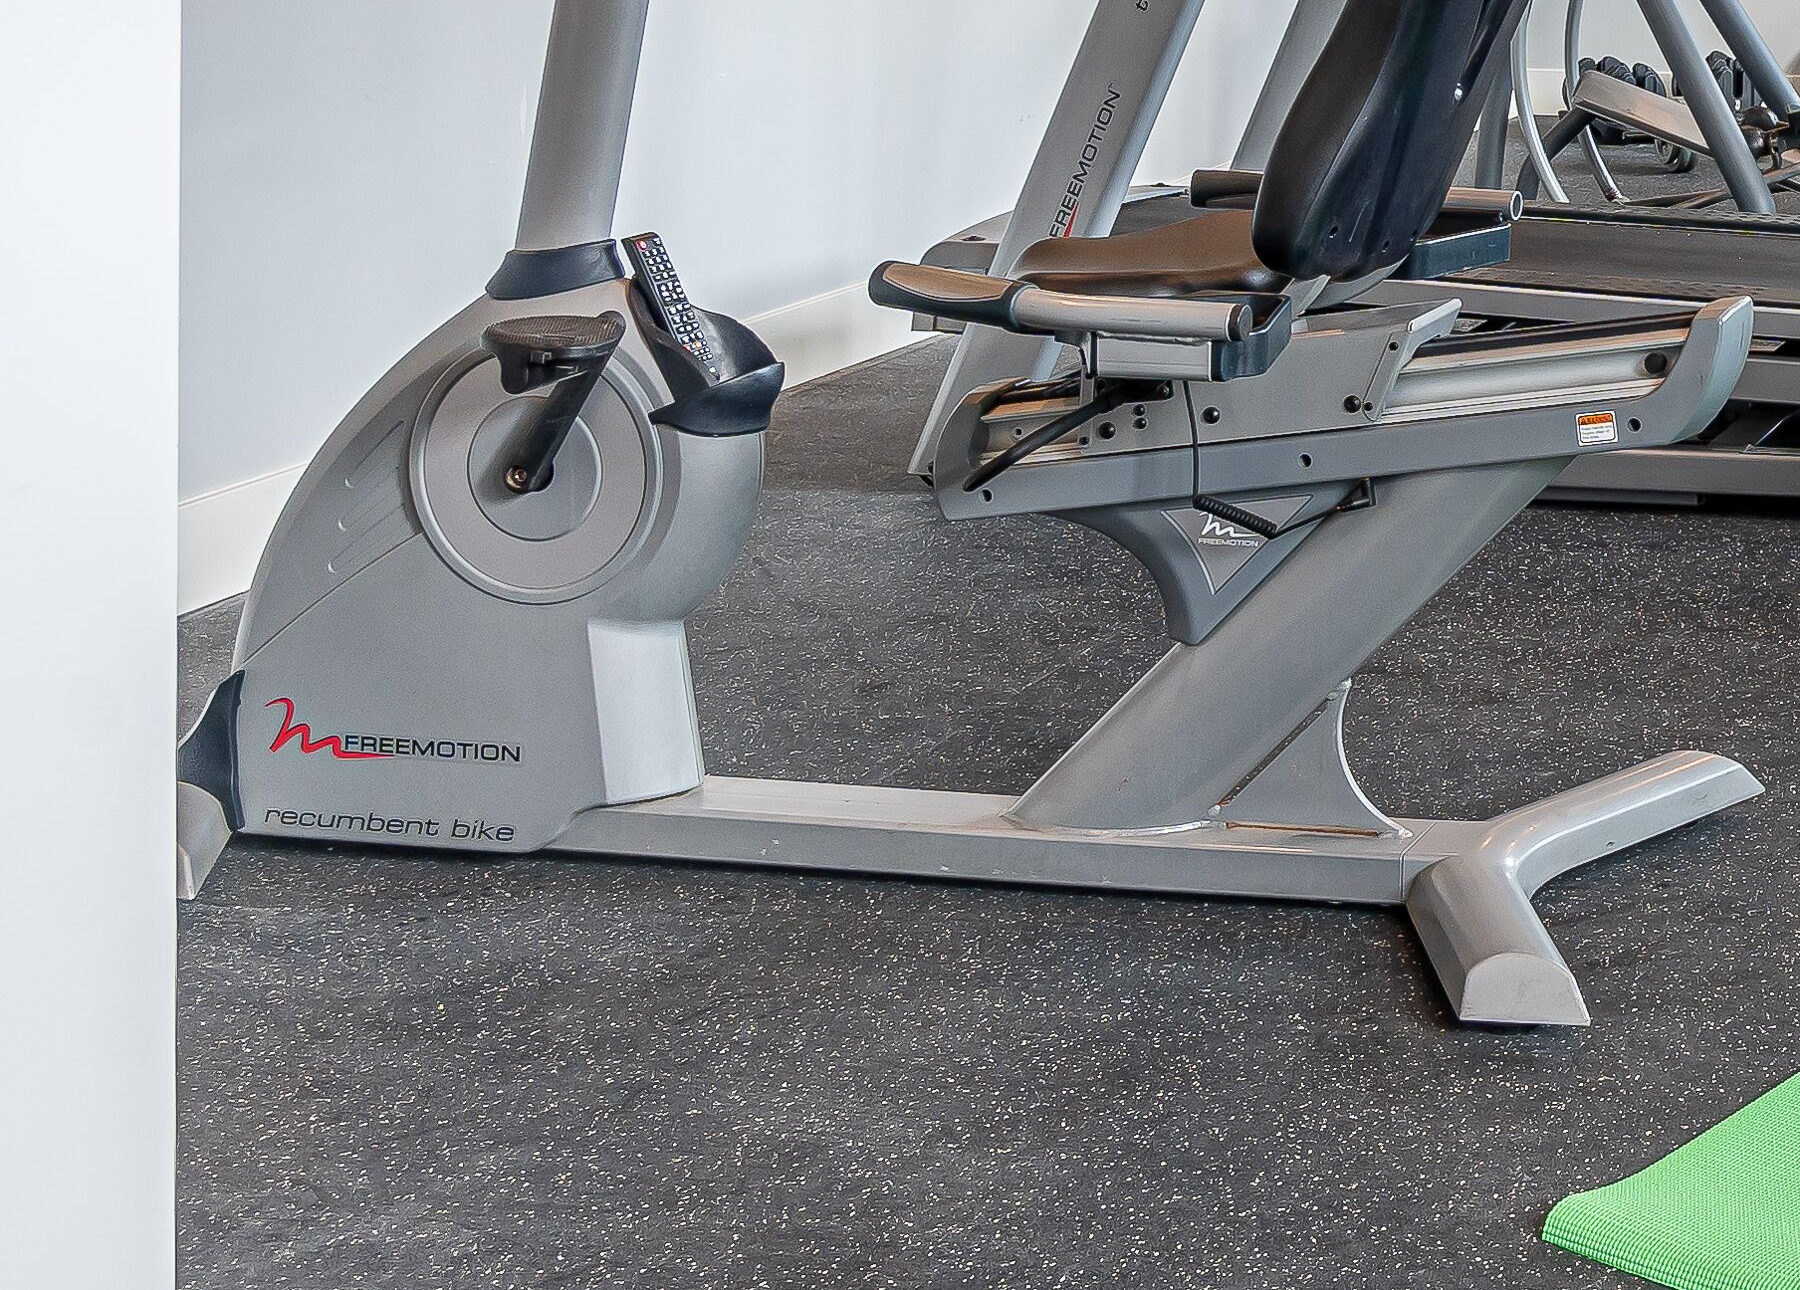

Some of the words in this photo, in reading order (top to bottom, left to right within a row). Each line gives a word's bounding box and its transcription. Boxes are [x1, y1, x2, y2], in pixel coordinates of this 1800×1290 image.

[1049, 89, 1121, 238] FREEMOTION
[1197, 537, 1259, 547] FREEMOTION
[344, 734, 521, 763] FREEMOTION
[264, 808, 440, 838] recumbent
[450, 818, 515, 843] bike
